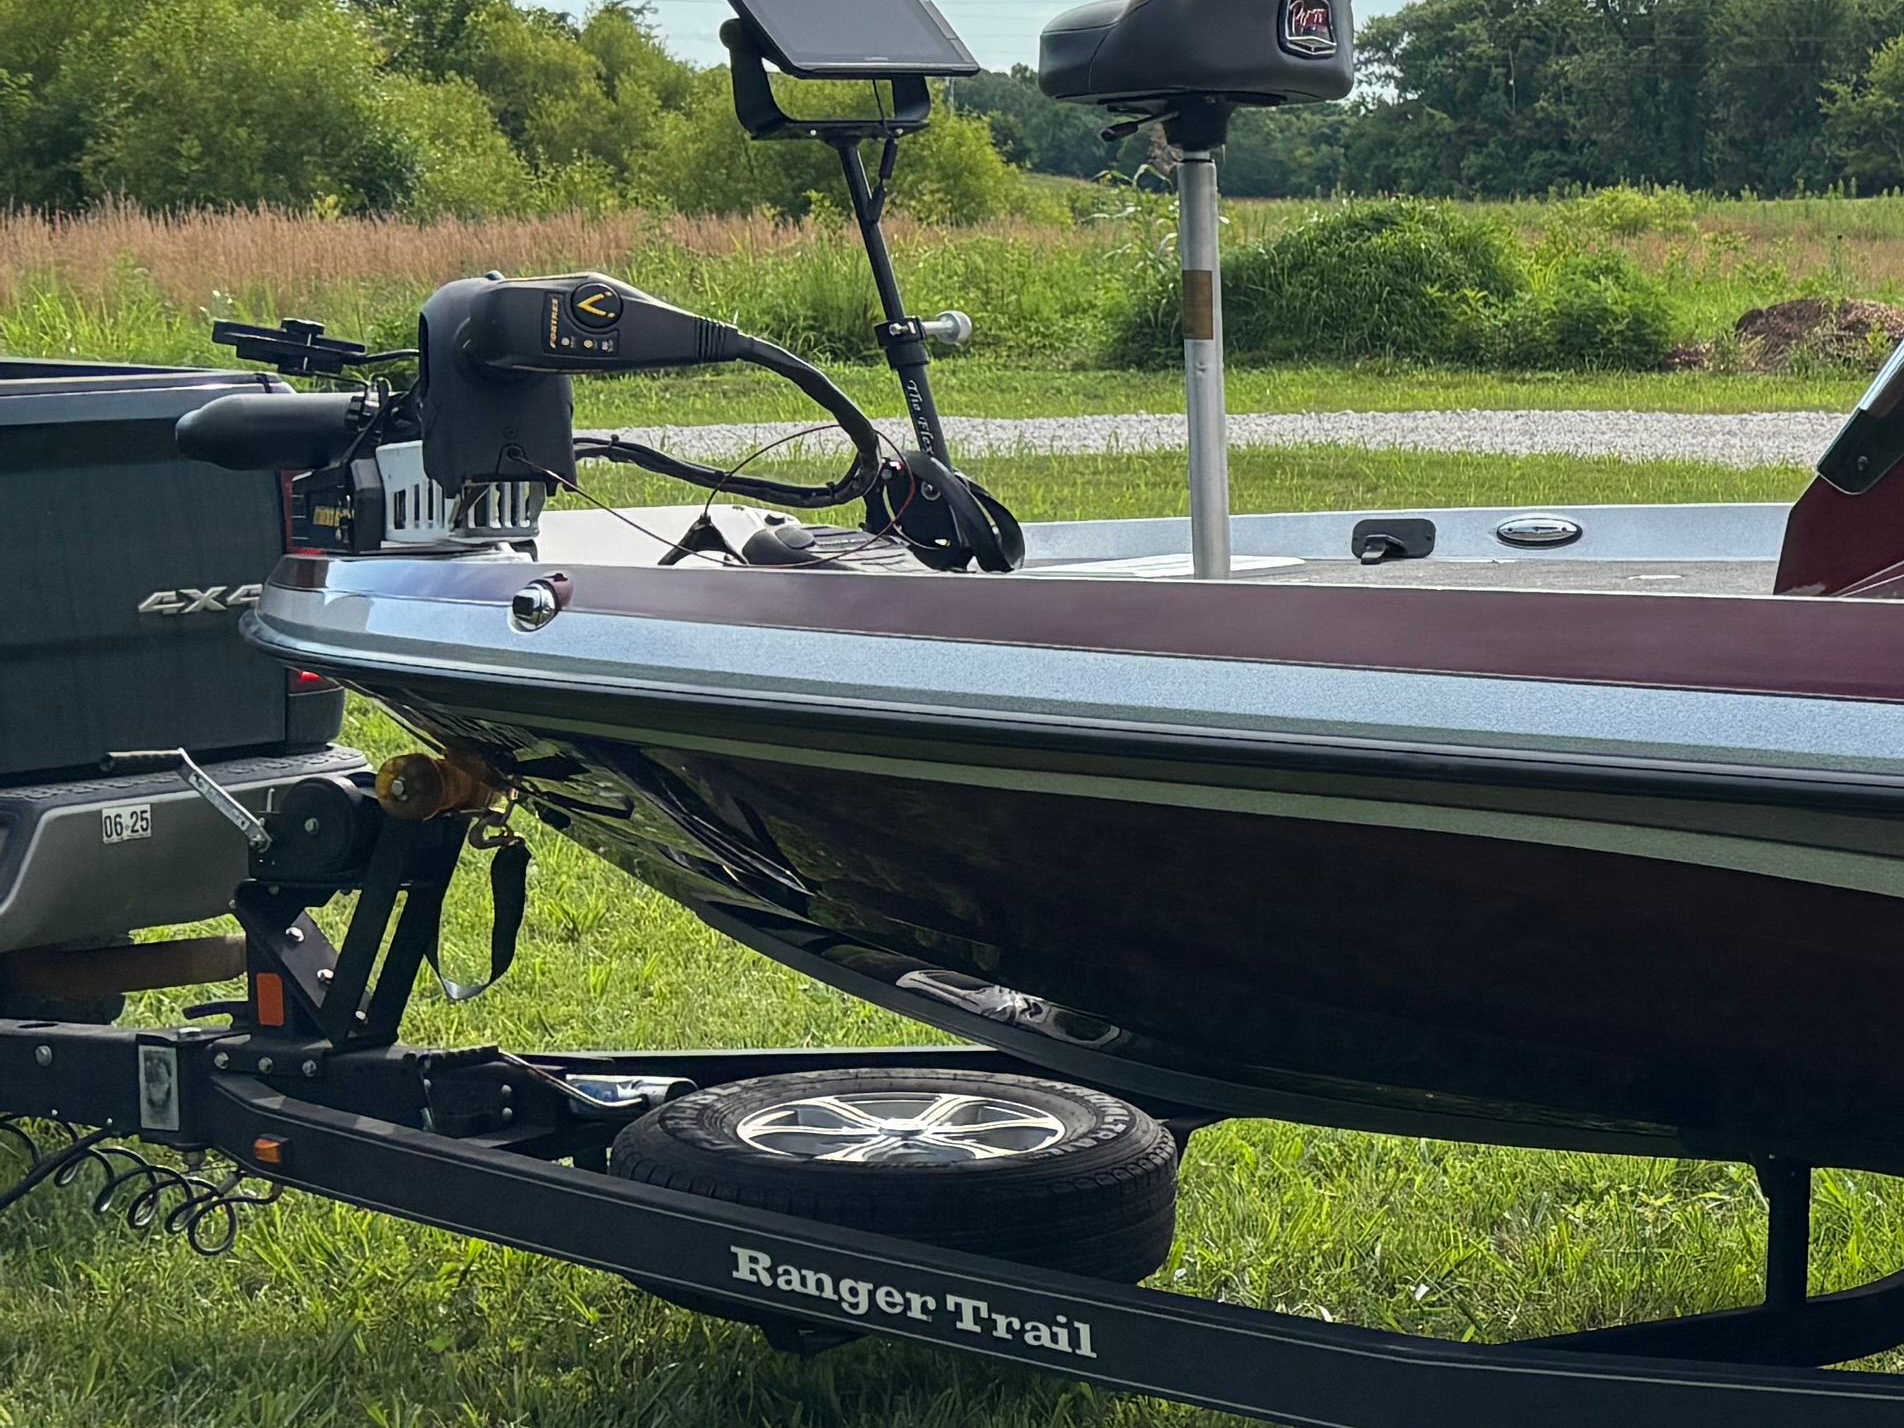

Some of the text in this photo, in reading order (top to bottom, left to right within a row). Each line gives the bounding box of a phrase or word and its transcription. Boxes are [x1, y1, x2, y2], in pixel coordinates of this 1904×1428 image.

[907, 380, 923, 411] The
[730, 1245, 1097, 1358] Ranger Trail
